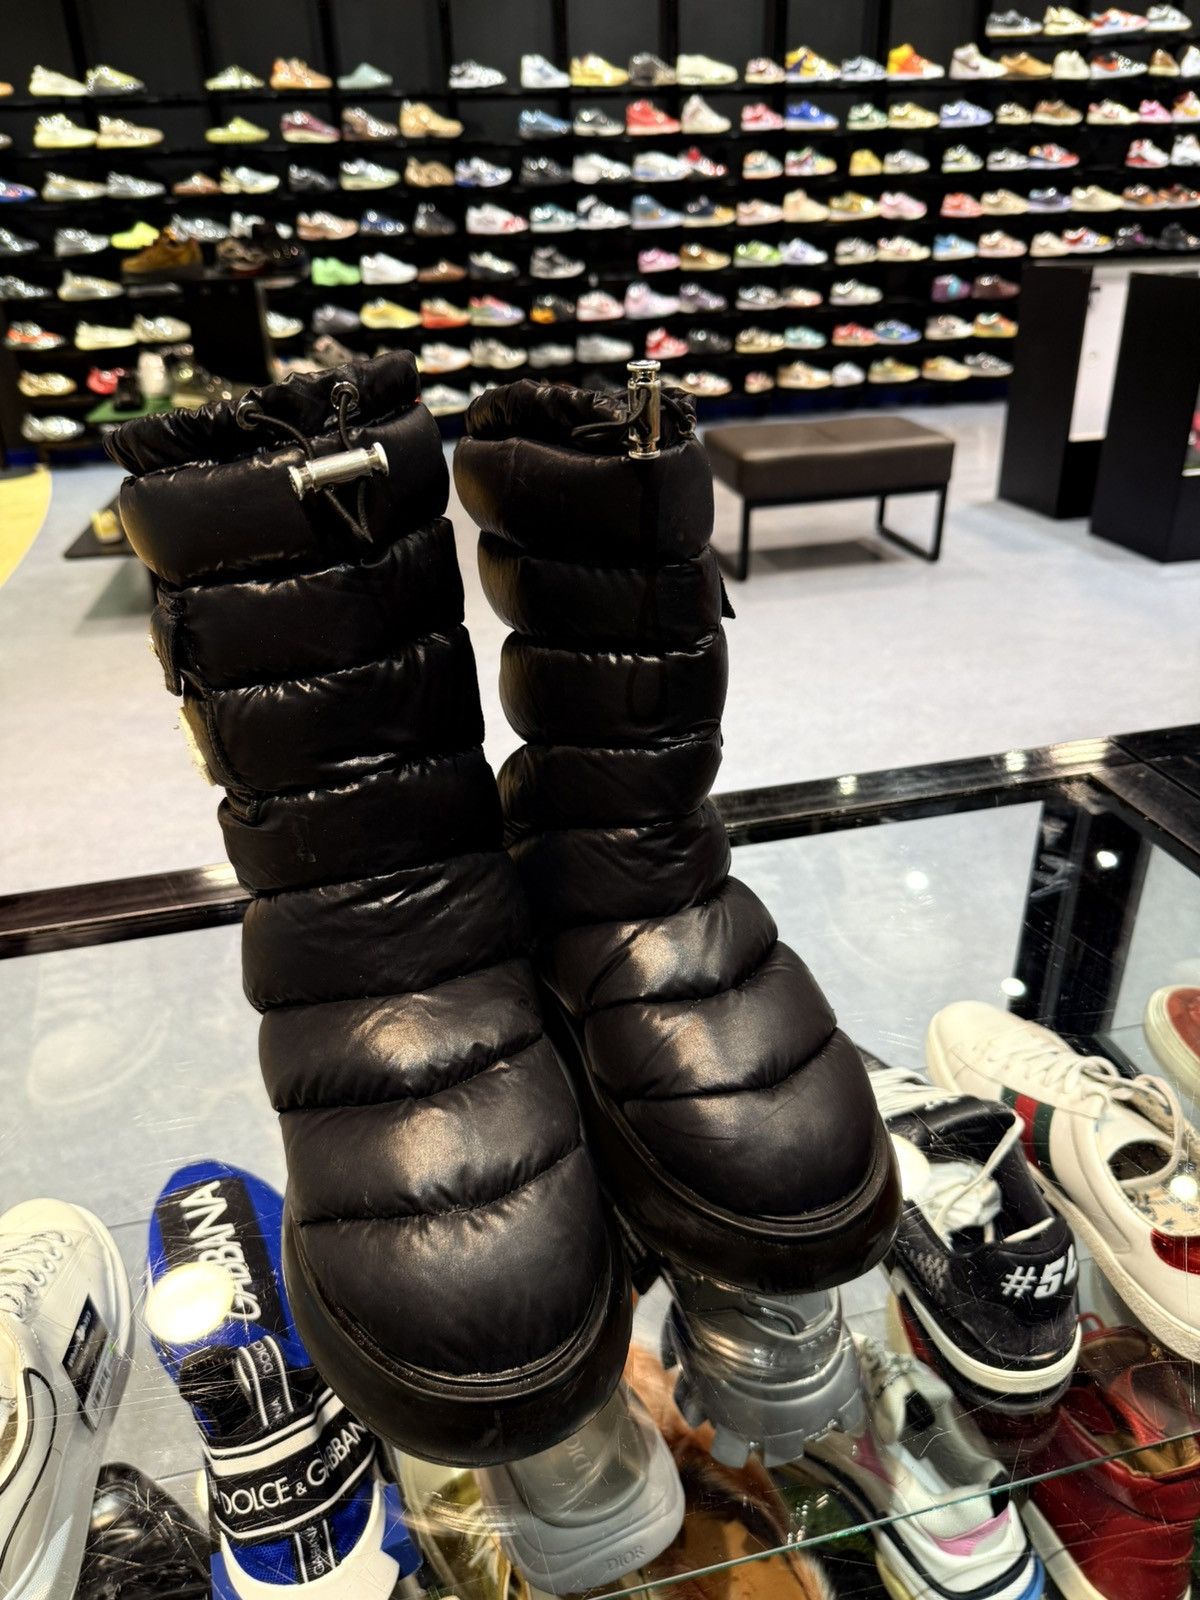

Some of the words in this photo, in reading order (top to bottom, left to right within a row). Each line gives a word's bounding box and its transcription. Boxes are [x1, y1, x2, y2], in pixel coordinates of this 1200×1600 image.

[219, 1476, 292, 1515] DOLCE
[295, 1482, 308, 1496] &
[306, 1421, 369, 1487] GABBAN
[606, 1546, 647, 1570] DIOR
